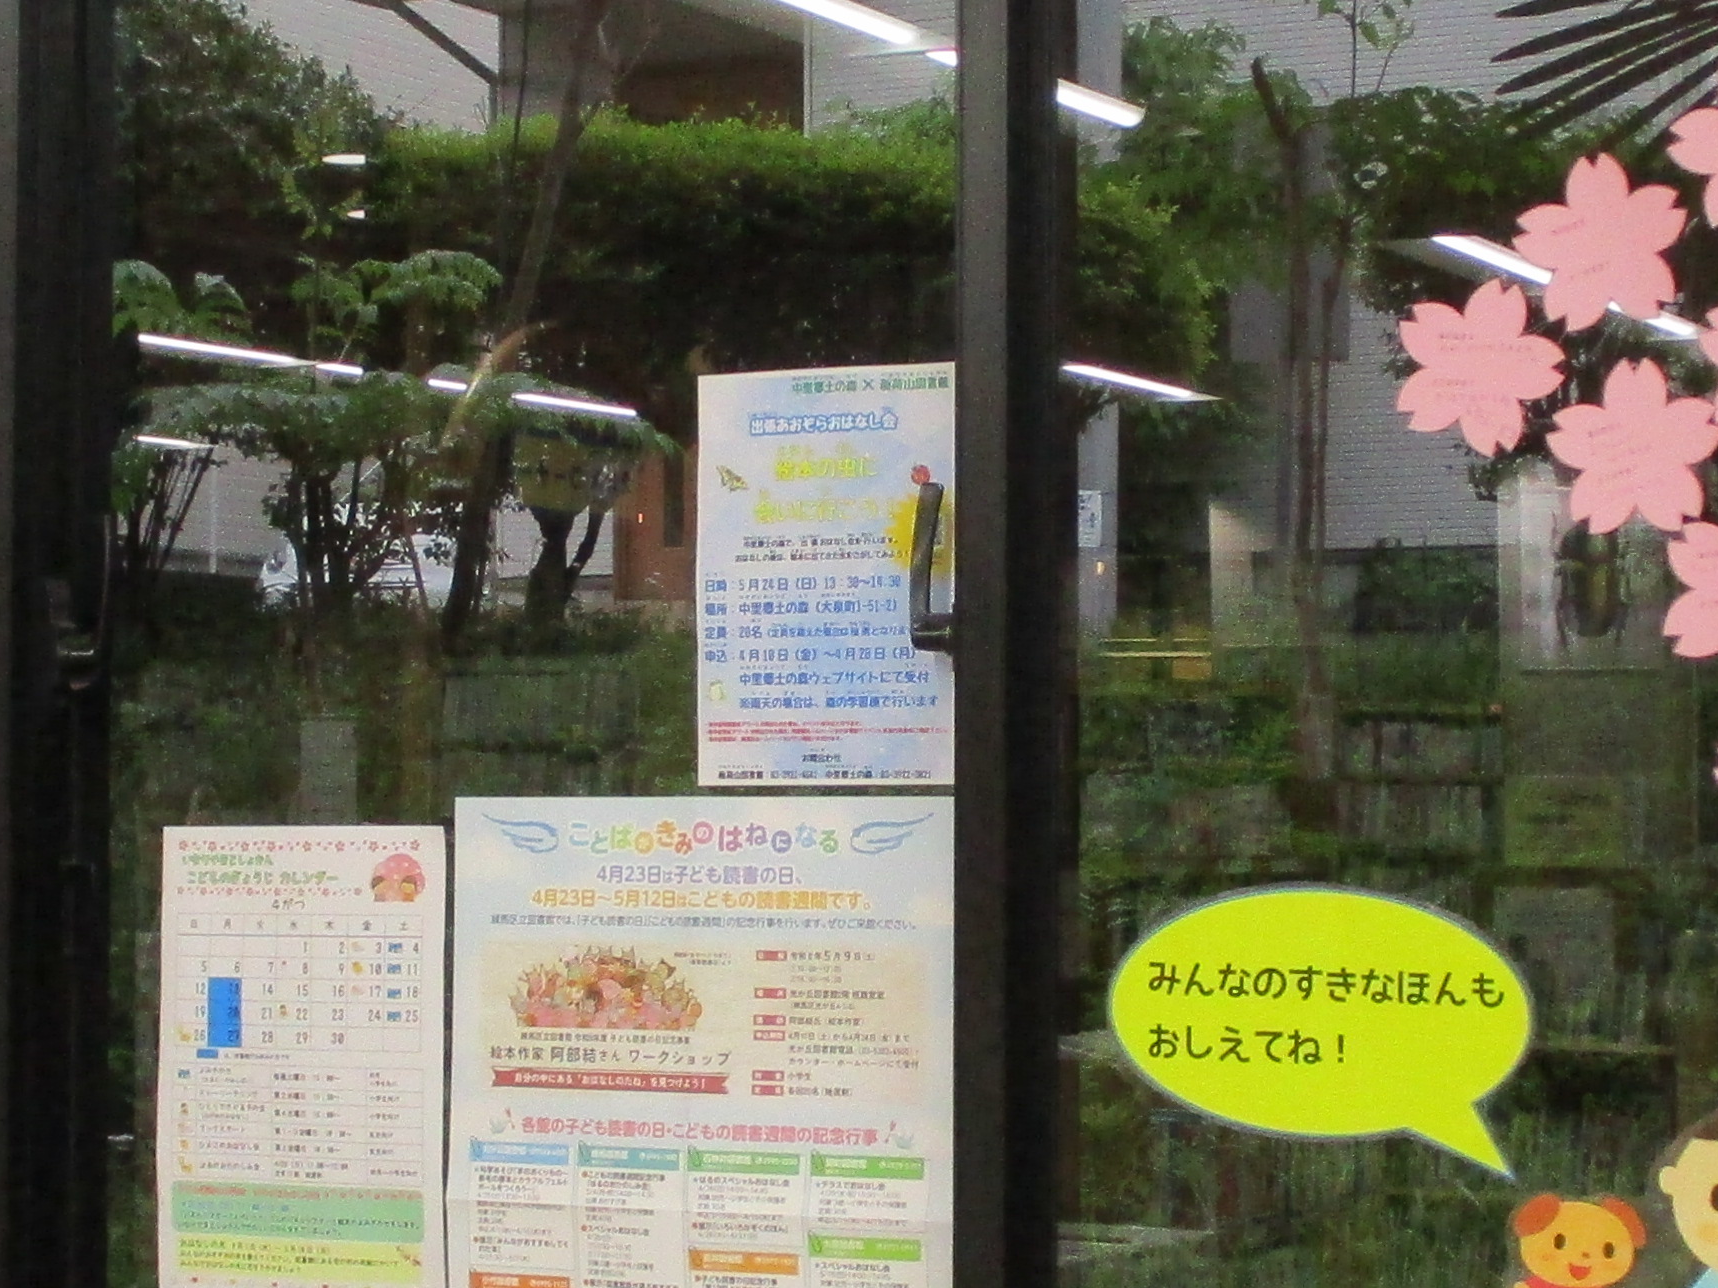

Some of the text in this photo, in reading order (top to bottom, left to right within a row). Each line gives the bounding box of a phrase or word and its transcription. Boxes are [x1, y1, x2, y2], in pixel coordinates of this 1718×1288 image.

[303, 942, 419, 953] 1 2 3 4
[201, 961, 418, 975] 5 6 7 8 9 10 11
[195, 983, 206, 994] 12
[262, 984, 273, 995] 14
[297, 984, 309, 996] 15
[333, 985, 345, 997] 16
[369, 986, 381, 998] 17
[406, 986, 418, 998] 18
[1146, 961, 1505, 1008] みんなのすきなほんも
[195, 1006, 205, 1018] 19
[261, 1007, 273, 1019] 21
[296, 1008, 308, 1020] 22
[332, 1008, 344, 1021] 23
[368, 1009, 381, 1021] 24
[405, 1010, 418, 1022] 25
[194, 1029, 205, 1041] 26
[262, 1031, 273, 1043] 28
[296, 1032, 309, 1043] 29
[331, 1032, 344, 1044] 30
[1148, 1023, 1346, 1065] おしえてね！
[629, 1050, 731, 1066] ワークショップ
